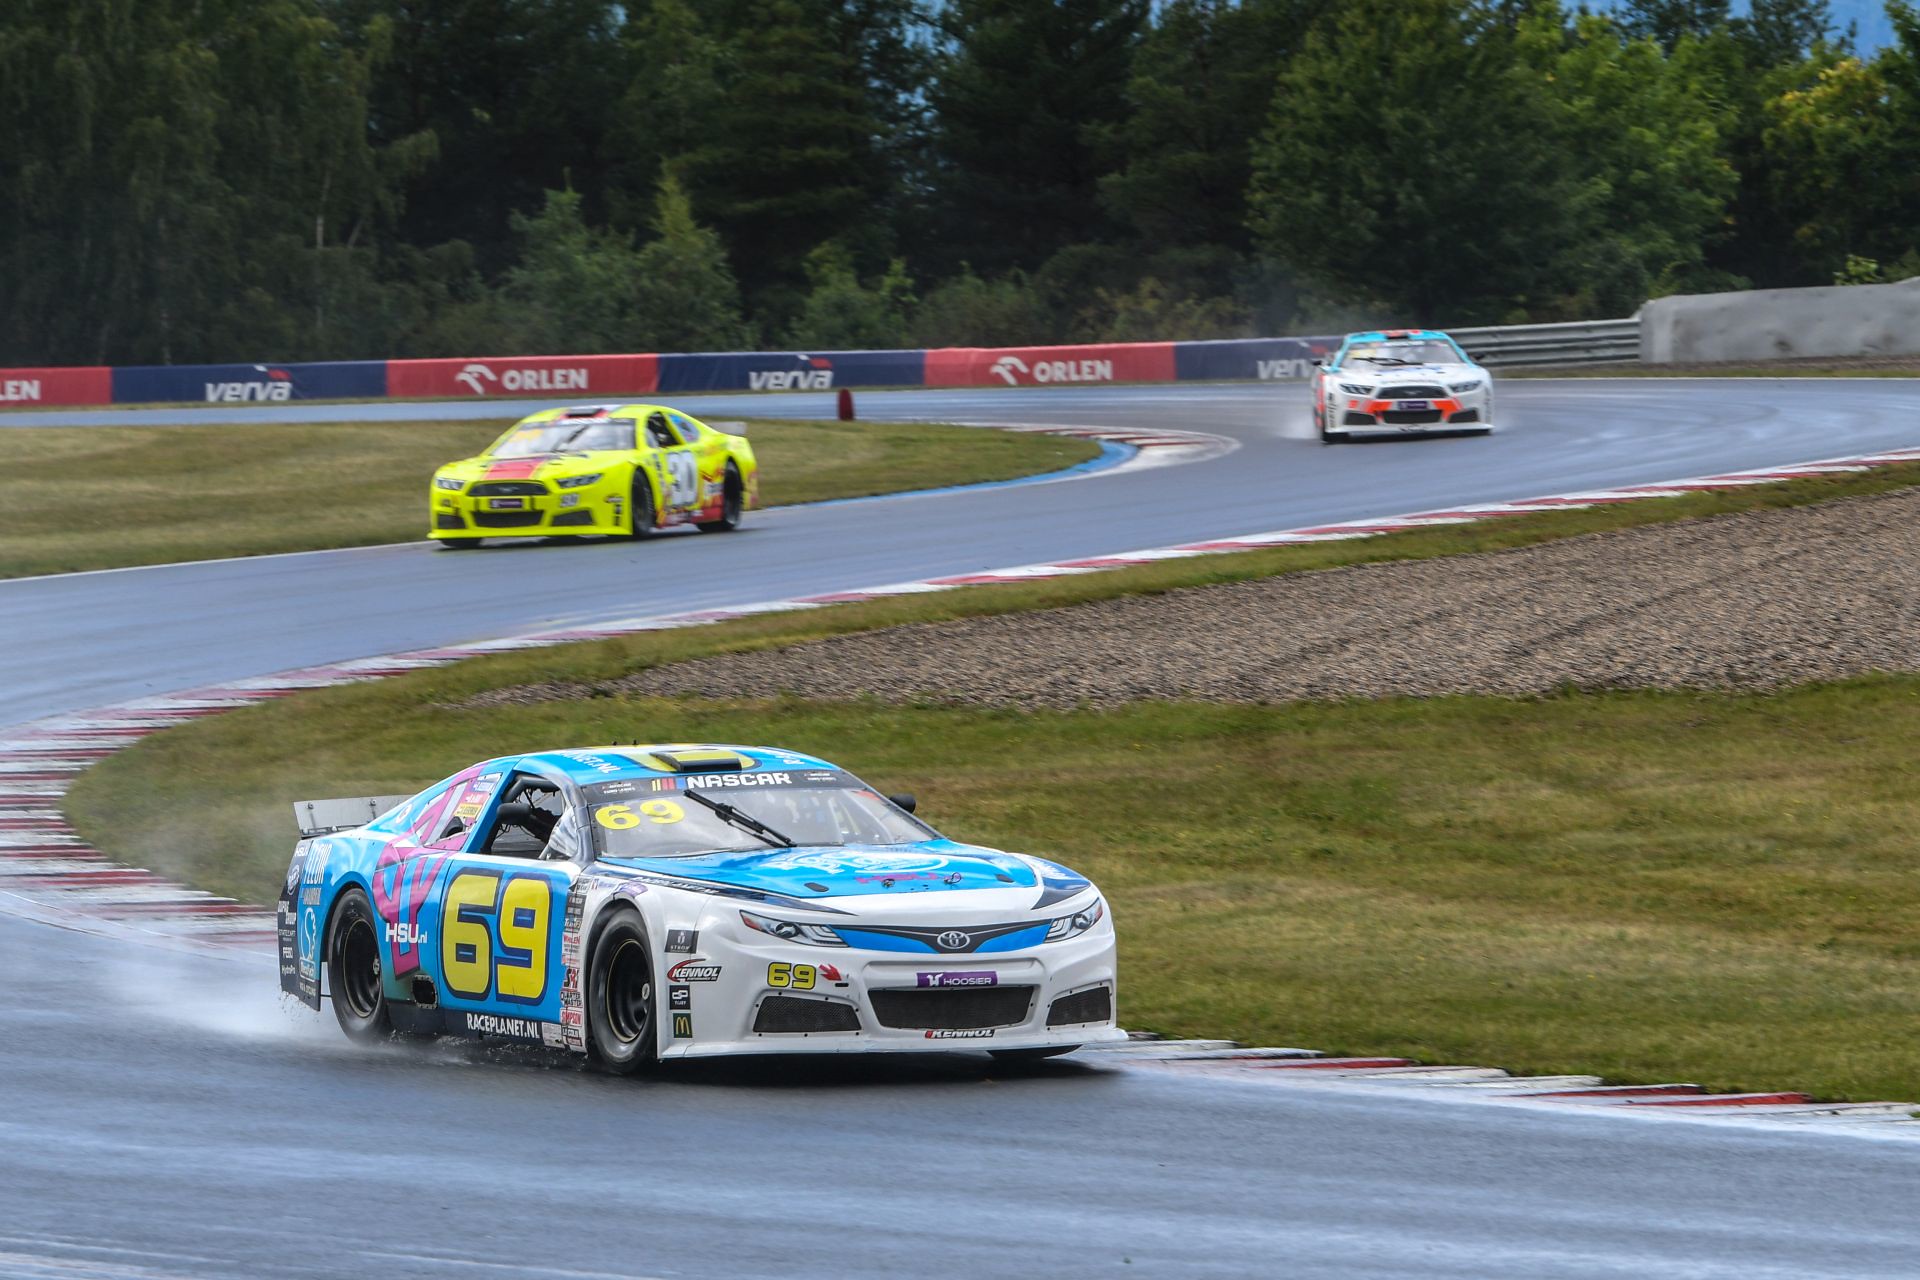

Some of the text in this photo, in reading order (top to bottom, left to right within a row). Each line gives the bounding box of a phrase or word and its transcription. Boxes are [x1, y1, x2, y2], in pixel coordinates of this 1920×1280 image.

[502, 368, 588, 391] ORLEN
[748, 370, 834, 390] verva
[1033, 360, 1112, 382] ORLEN
[205, 382, 292, 402] verva
[686, 773, 793, 789] NASCAR
[595, 798, 684, 829] 69
[385, 922, 428, 944] HSU.nl
[441, 867, 553, 1006] 69
[671, 967, 719, 978] KENNOL
[767, 961, 817, 991] 69
[943, 977, 992, 986] HOOSIER
[466, 1012, 540, 1039] RACEPLANET.NL
[931, 1029, 994, 1038] KENNOL
